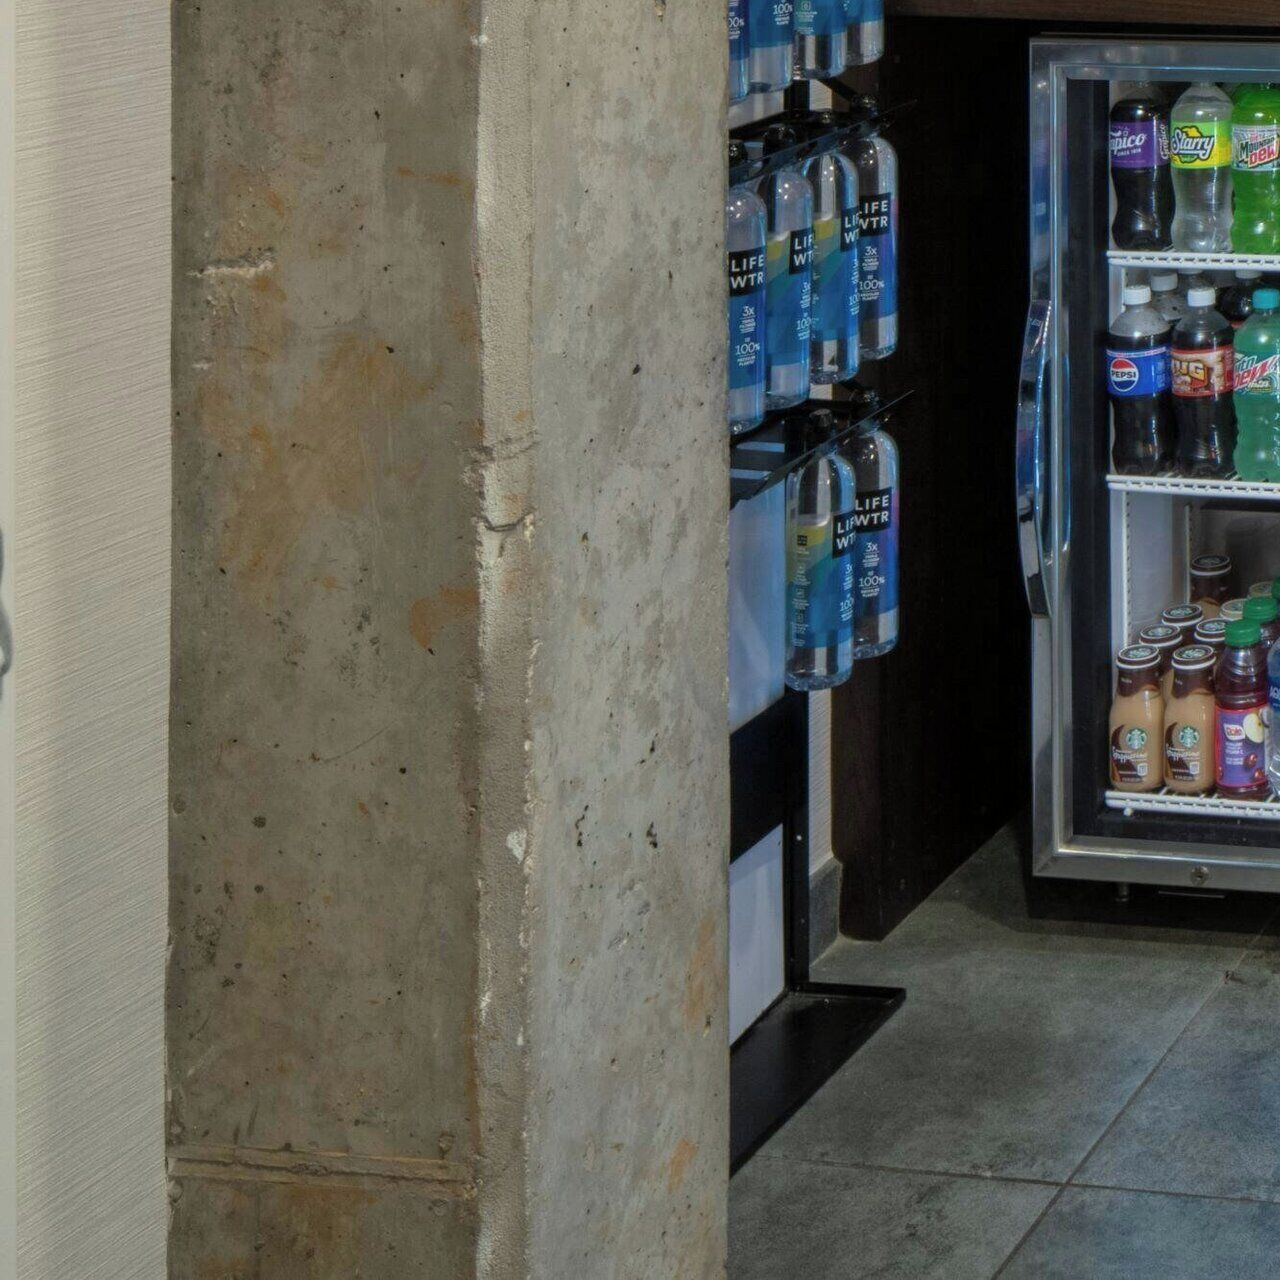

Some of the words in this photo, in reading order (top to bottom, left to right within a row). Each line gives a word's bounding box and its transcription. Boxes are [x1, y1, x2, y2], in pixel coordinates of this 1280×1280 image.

[1171, 128, 1215, 161] Starry
[731, 253, 765, 272] LIFE
[730, 271, 765, 290] WTR
[1110, 369, 1138, 379] PEPSI
[855, 495, 890, 511] LIFE
[855, 510, 890, 526] WTR
